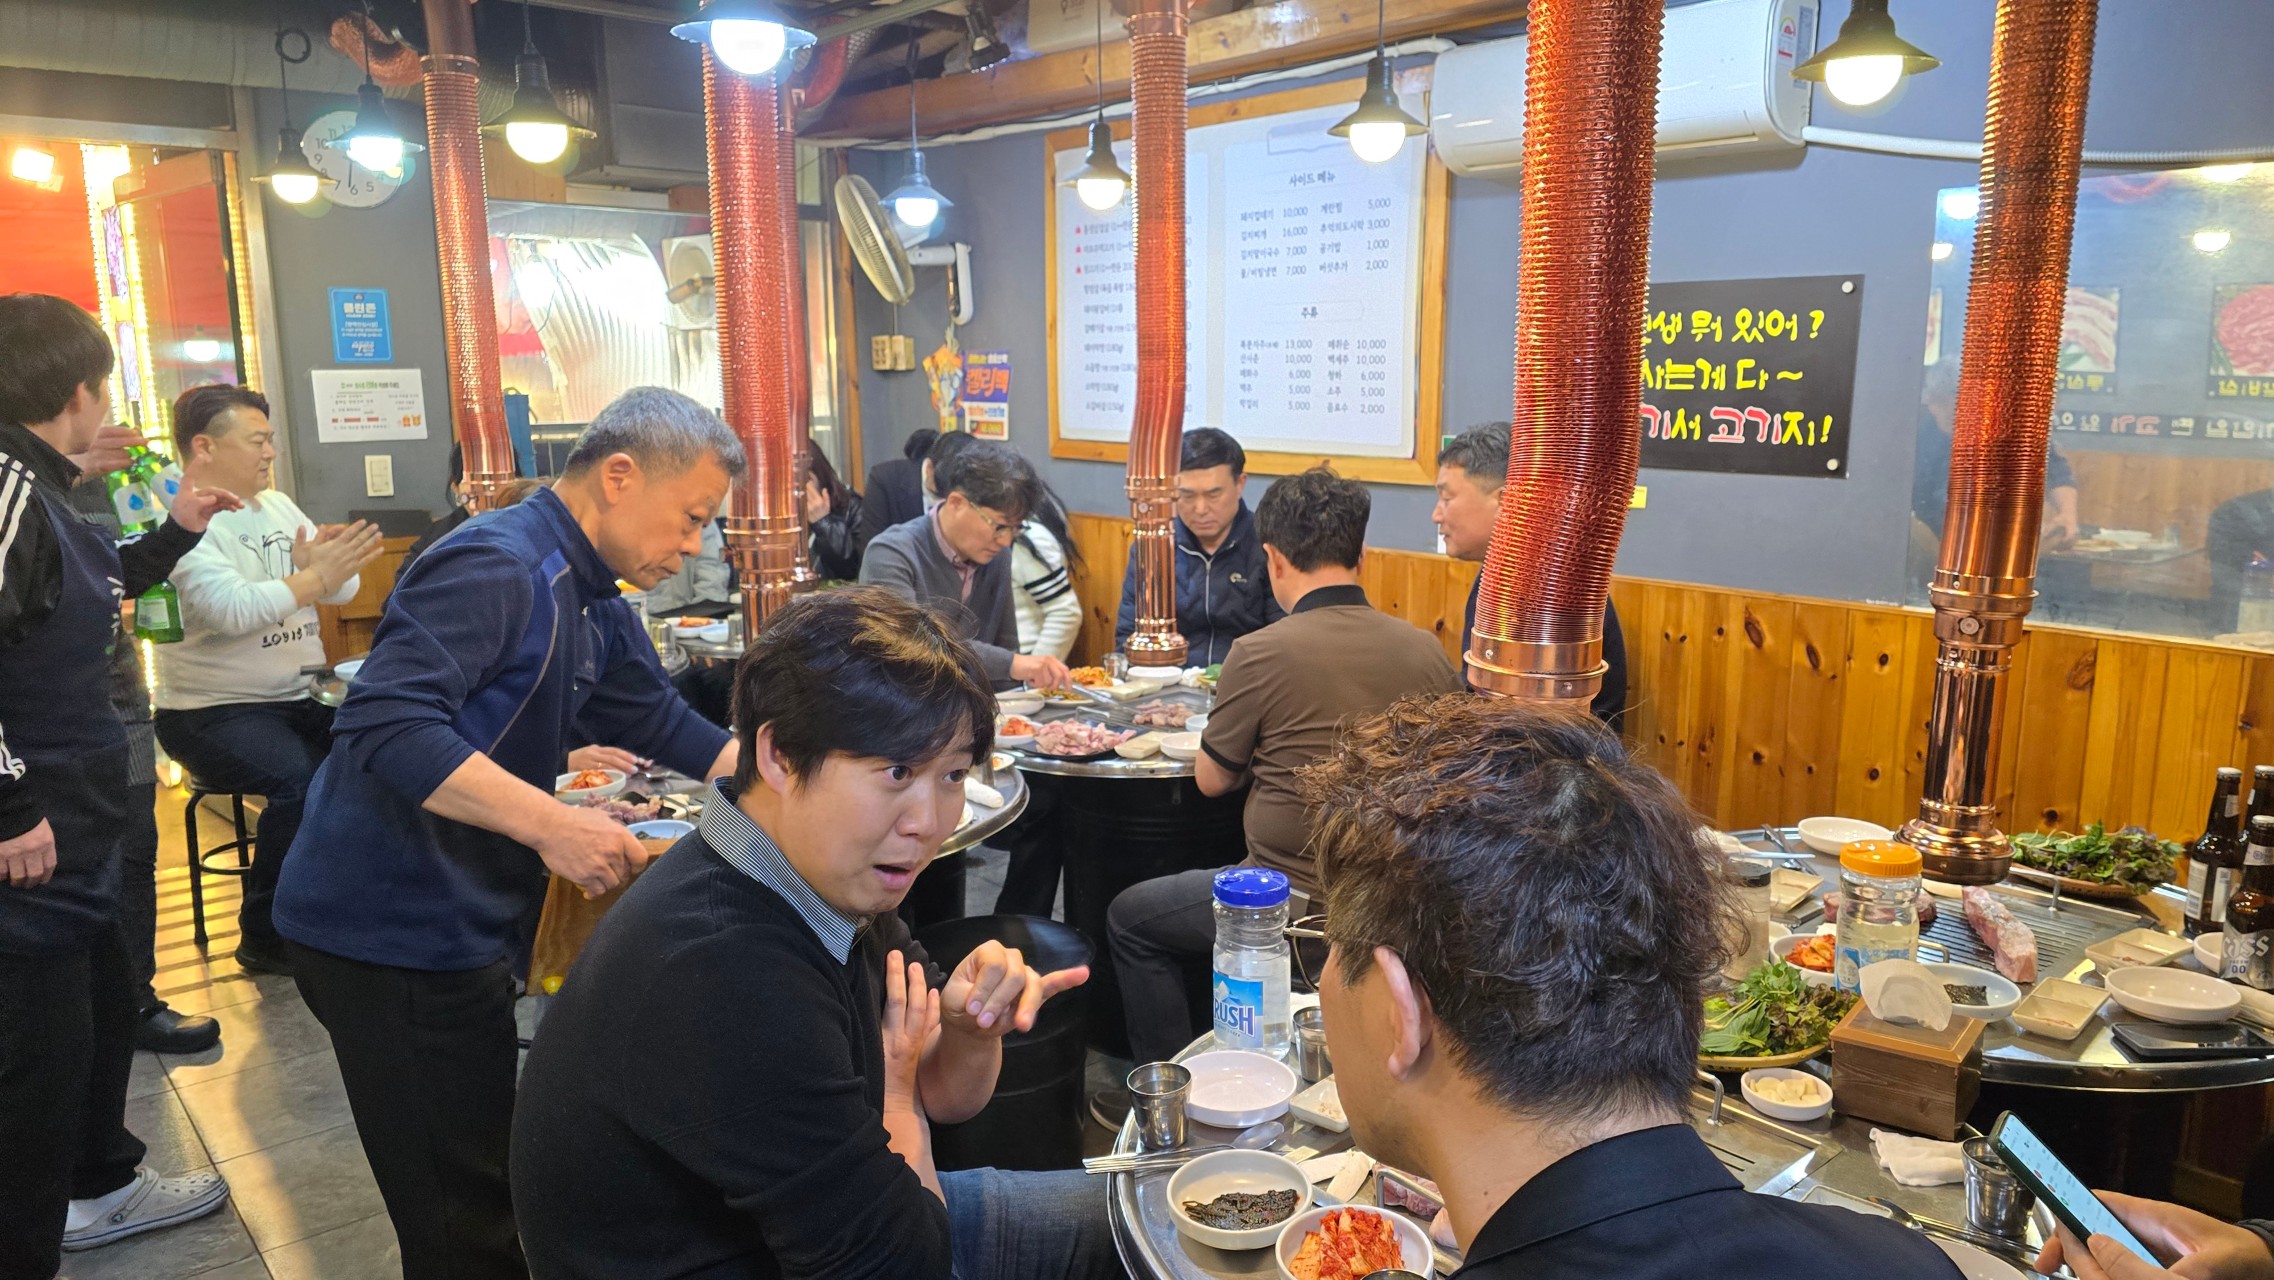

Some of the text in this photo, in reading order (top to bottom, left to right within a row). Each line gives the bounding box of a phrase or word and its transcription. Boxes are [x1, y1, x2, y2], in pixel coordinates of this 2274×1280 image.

[314, 154, 322, 164] 9
[1289, 171, 1336, 187] 사이드 메뉴
[350, 185, 358, 195] 6
[366, 182, 374, 192] 5
[1368, 198, 1391, 209] 5,000
[1283, 206, 1308, 218] 10,000
[1368, 218, 1390, 230] 3,000
[1283, 226, 1308, 237] 16,000
[1367, 239, 1389, 250] 1,000
[1286, 246, 1307, 256] 7,000
[1366, 259, 1388, 271] 2,000
[1286, 265, 1306, 276] 7,000
[1301, 306, 1318, 319] 주류
[1691, 311, 1721, 342] 뭐
[1285, 339, 1312, 349] 13,000
[1356, 339, 1386, 349] 10,000
[1285, 354, 1312, 364] 10,000
[1356, 355, 1386, 365] 10,000
[1289, 370, 1311, 379] 6,000
[1361, 371, 1385, 381] 6,000
[1288, 385, 1311, 394] 5,000
[1361, 387, 1385, 397] 5,000
[1288, 401, 1310, 410] 5,000
[1360, 404, 1385, 414] 2,000
[1708, 406, 1833, 446] 고기지!
